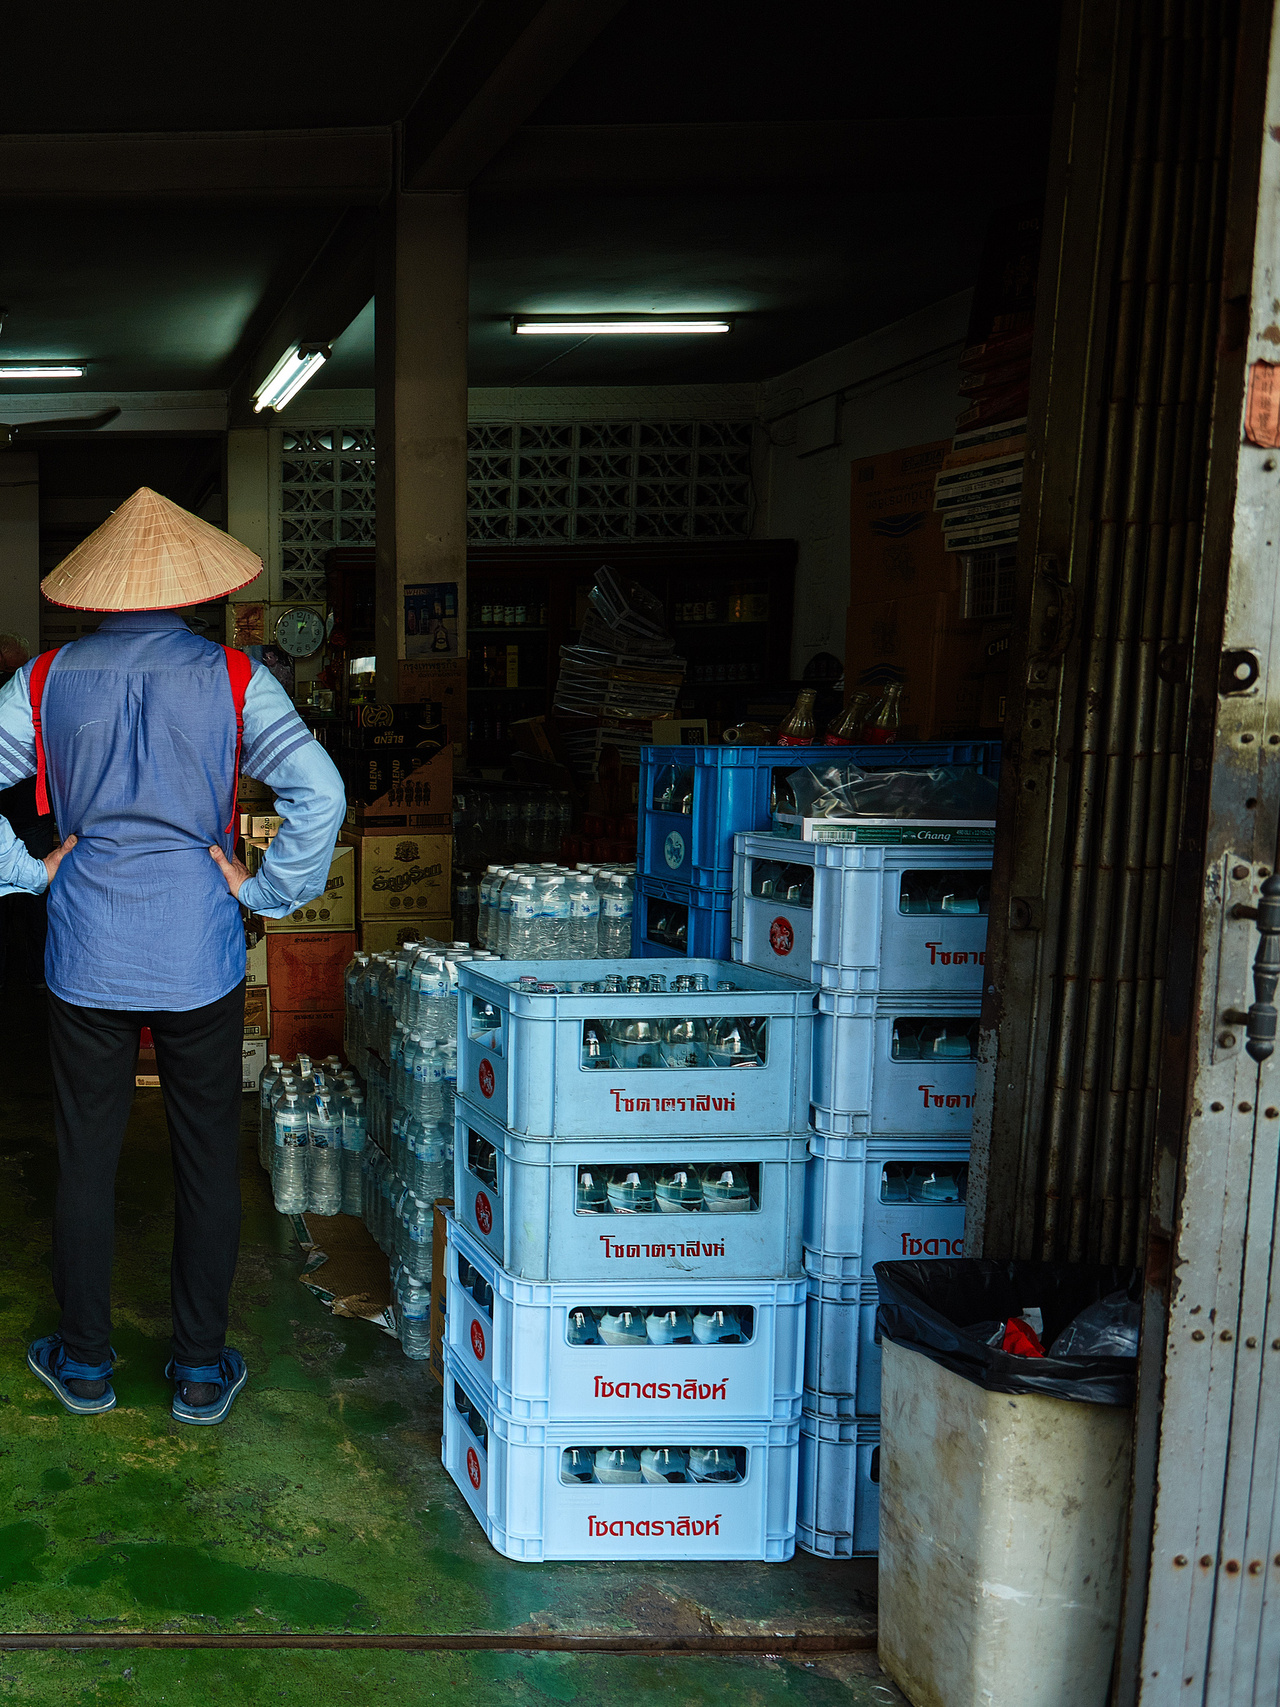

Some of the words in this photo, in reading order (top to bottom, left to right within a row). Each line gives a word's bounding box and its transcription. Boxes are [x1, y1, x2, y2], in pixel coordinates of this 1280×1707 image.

[373, 735, 405, 745] BLEND
[369, 760, 378, 791] BLEND
[917, 830, 952, 842] Chang
[918, 1085, 977, 1108] โซดา
[593, 1375, 729, 1400] โซดาตราสิงห์
[587, 1514, 722, 1537] โซดาตราสิงห์
